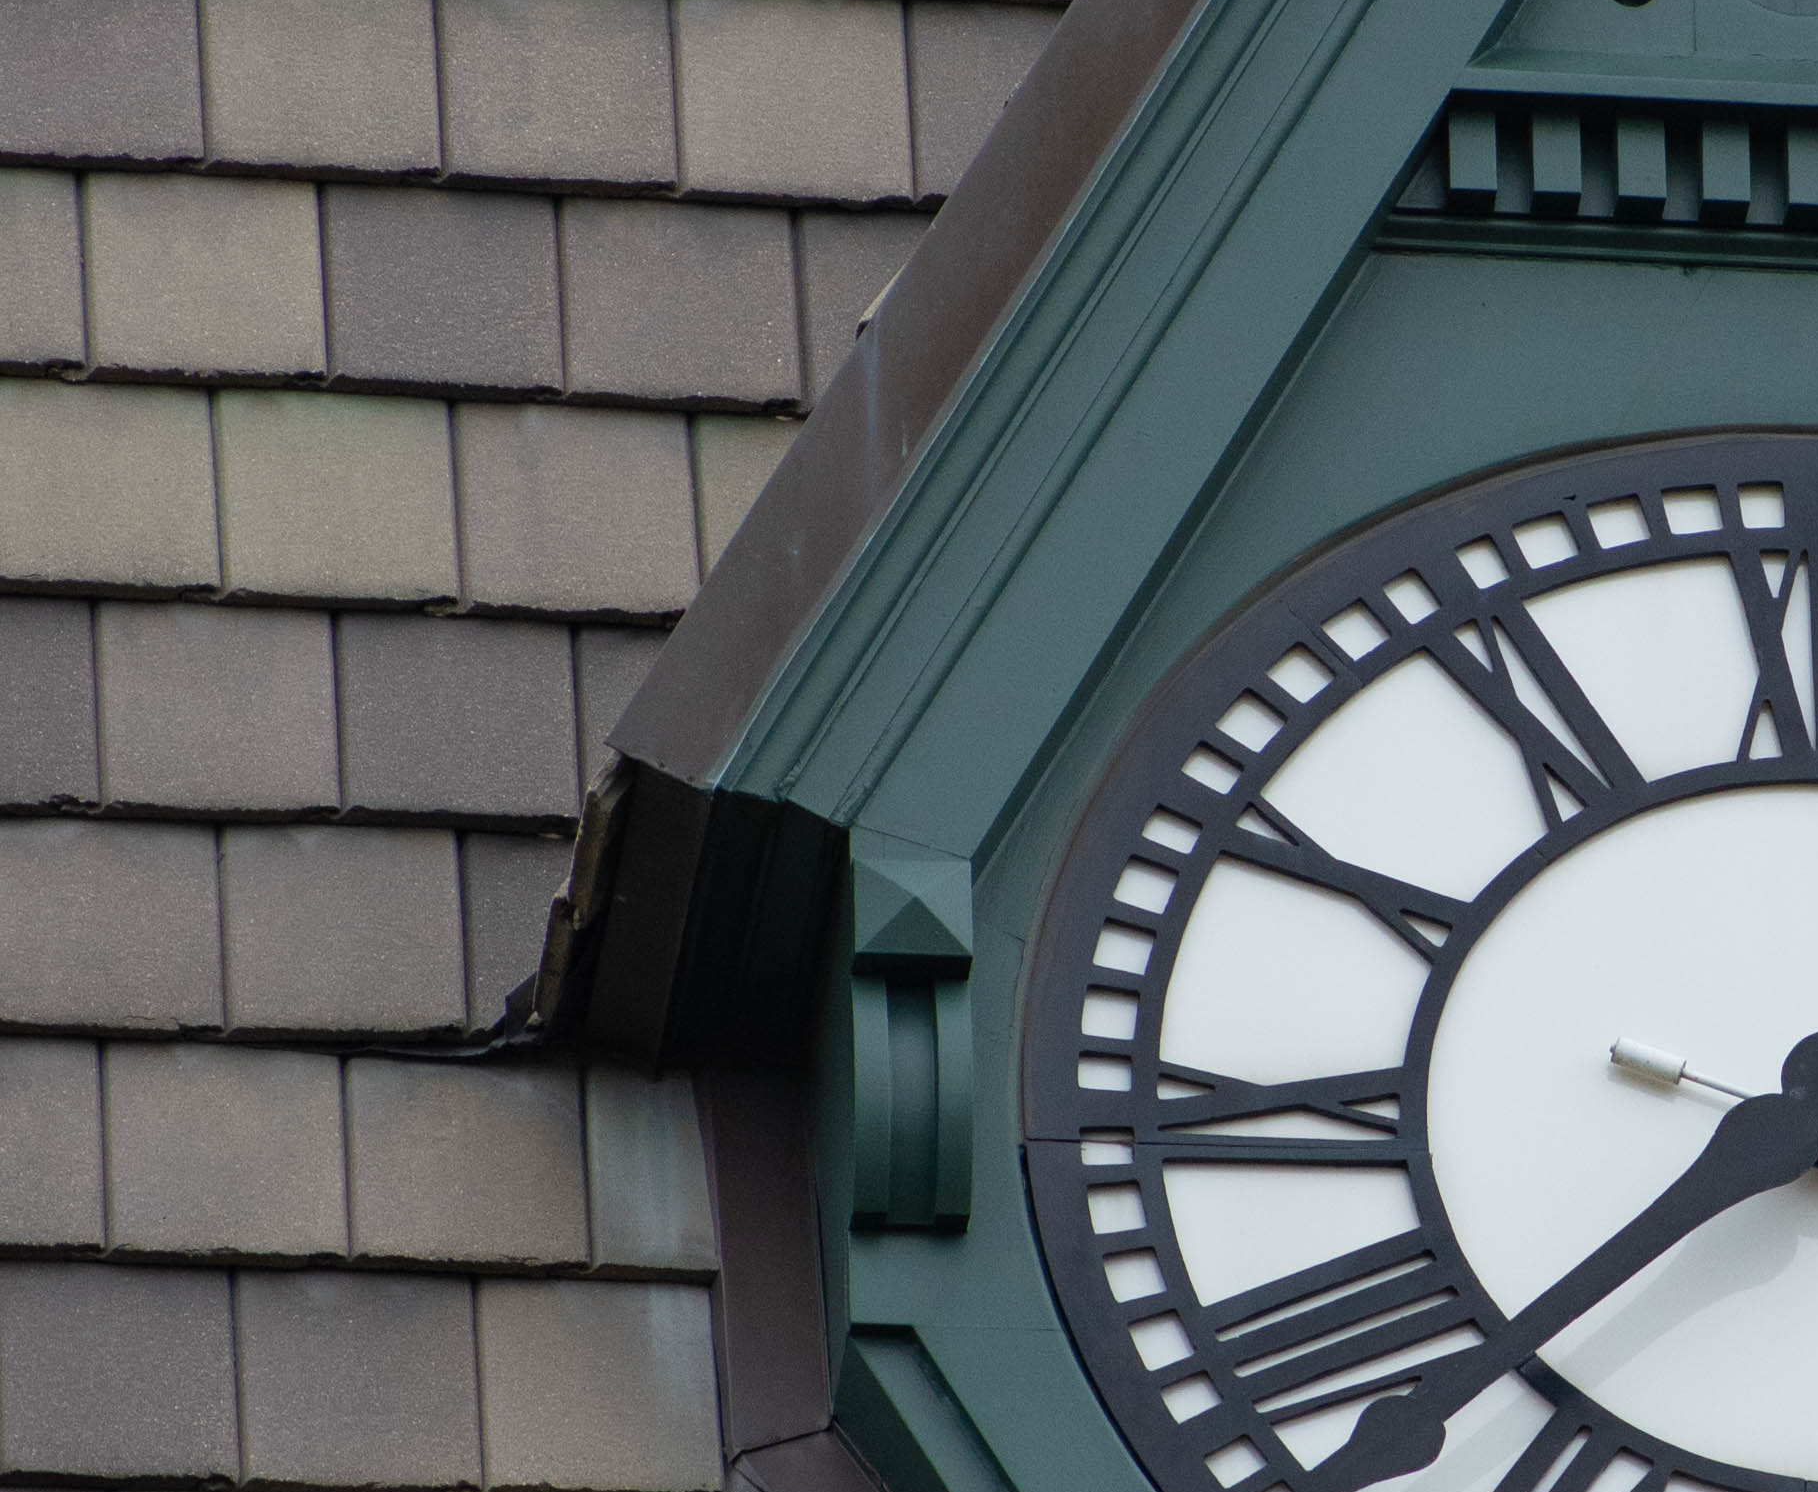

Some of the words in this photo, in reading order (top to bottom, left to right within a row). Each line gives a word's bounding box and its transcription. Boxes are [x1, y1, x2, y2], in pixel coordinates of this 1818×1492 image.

[1427, 604, 1650, 827] XI
[1223, 800, 1473, 965] X
[1155, 1060, 1427, 1164] IX
